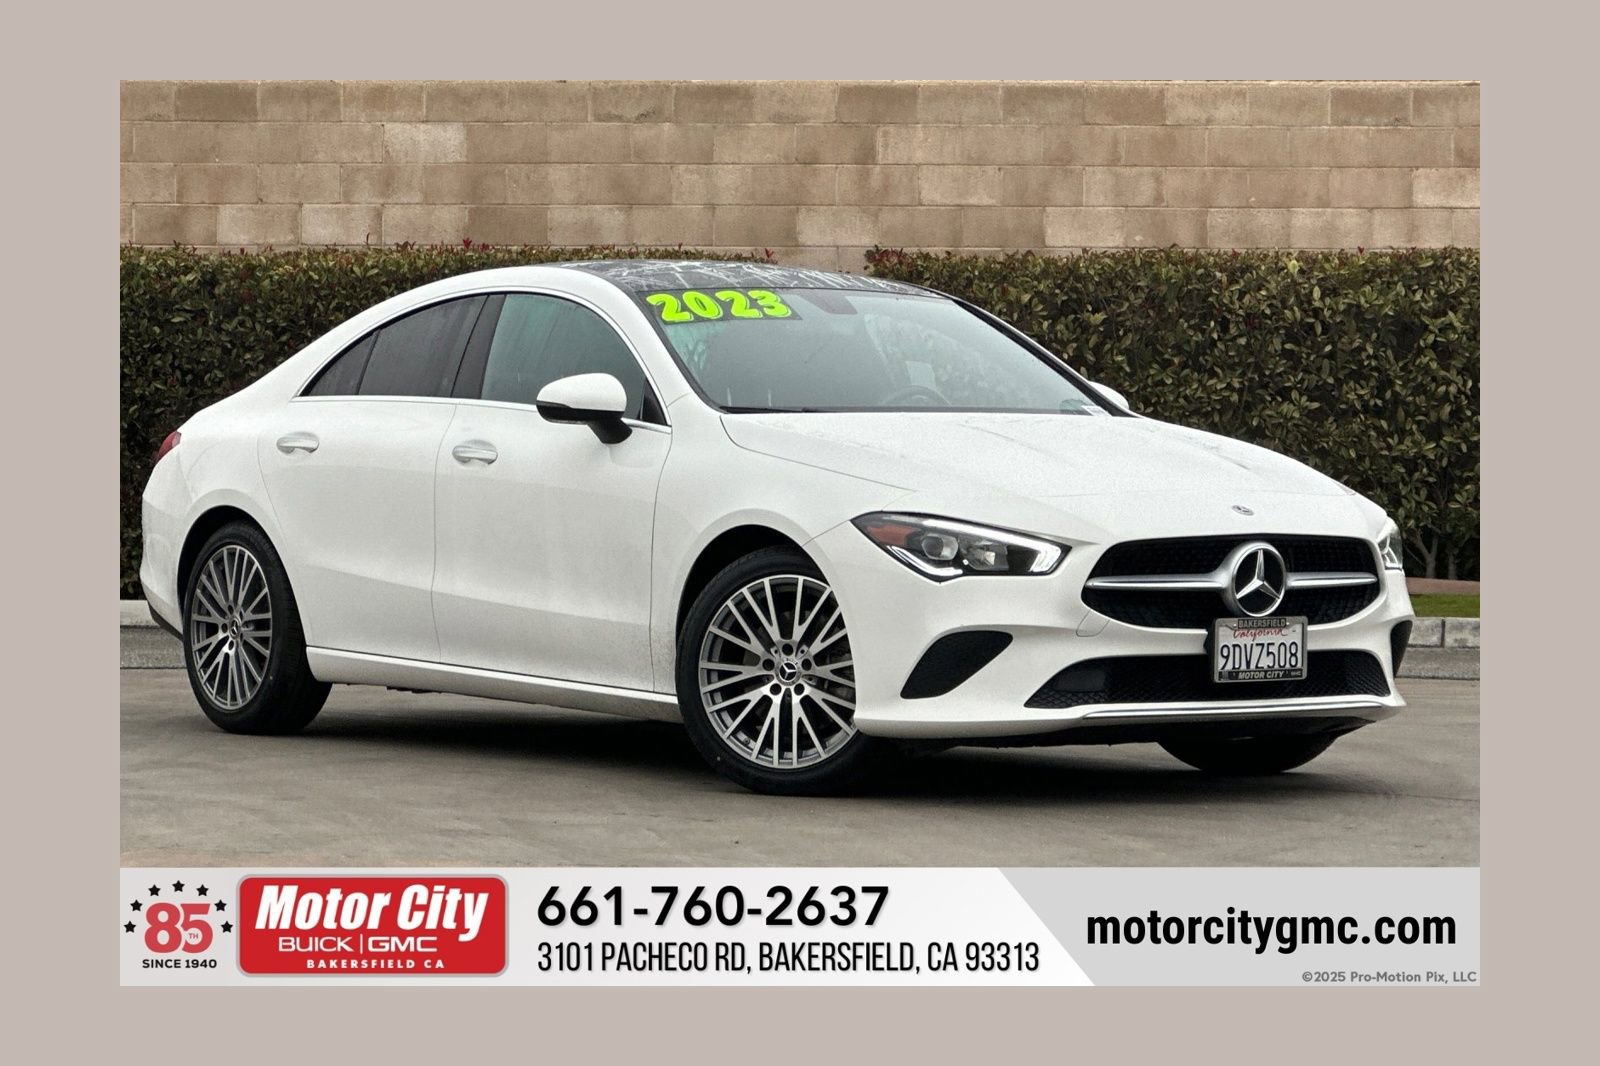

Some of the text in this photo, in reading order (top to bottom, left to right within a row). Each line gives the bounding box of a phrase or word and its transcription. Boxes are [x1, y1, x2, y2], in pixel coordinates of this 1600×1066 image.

[646, 290, 792, 322] 2023
[1238, 619, 1286, 628] BAKERSFIELD
[1233, 629, 1288, 641] California
[1220, 642, 1298, 670] 9DVZ508
